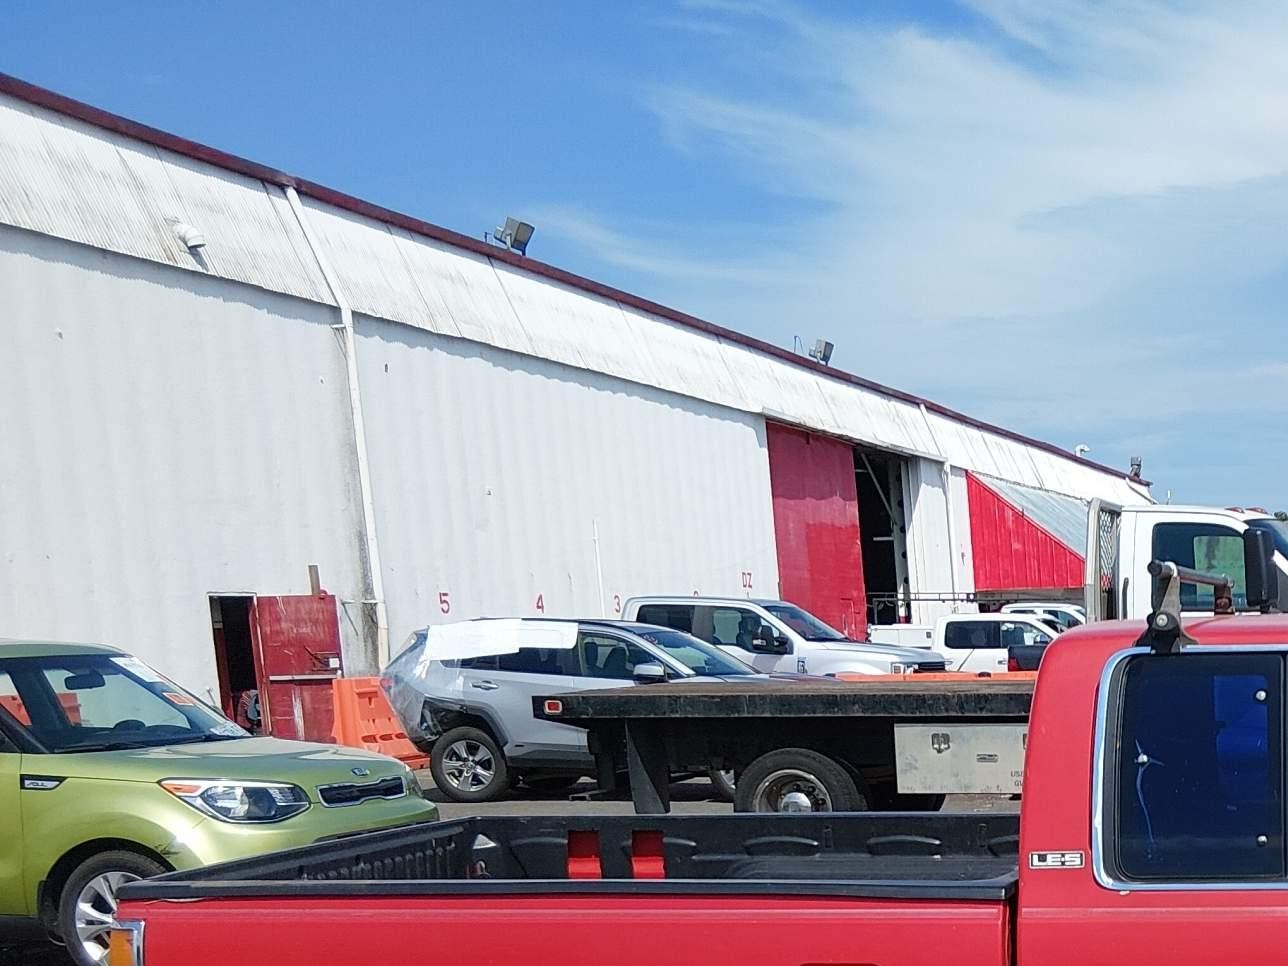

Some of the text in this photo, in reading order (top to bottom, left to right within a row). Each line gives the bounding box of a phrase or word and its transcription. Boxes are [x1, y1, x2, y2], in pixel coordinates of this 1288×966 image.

[439, 592, 450, 614] 5
[536, 593, 545, 614] 4
[613, 595, 621, 613] 3
